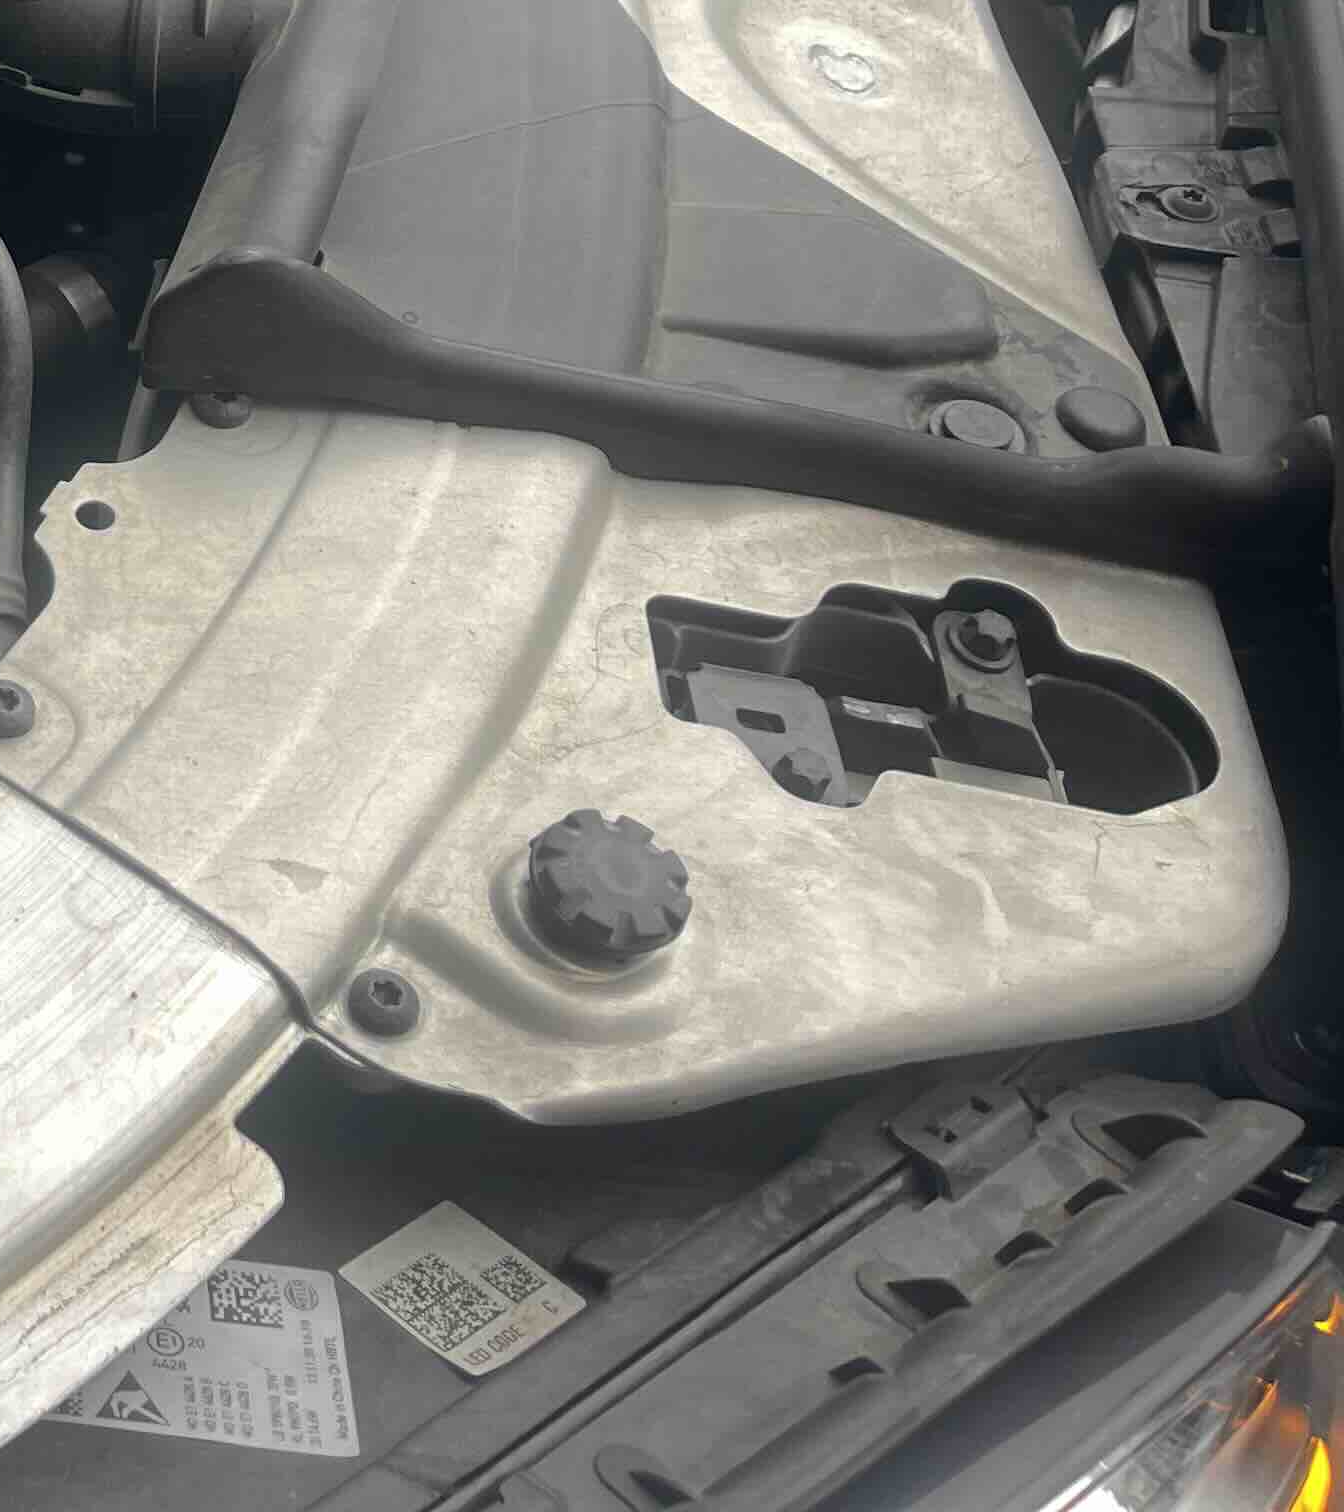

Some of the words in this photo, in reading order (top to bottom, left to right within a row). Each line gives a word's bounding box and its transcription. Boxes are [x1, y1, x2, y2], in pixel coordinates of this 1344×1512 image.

[186, 1336, 207, 1350] 20
[464, 1347, 493, 1367] LED
[487, 1322, 526, 1353] CODE
